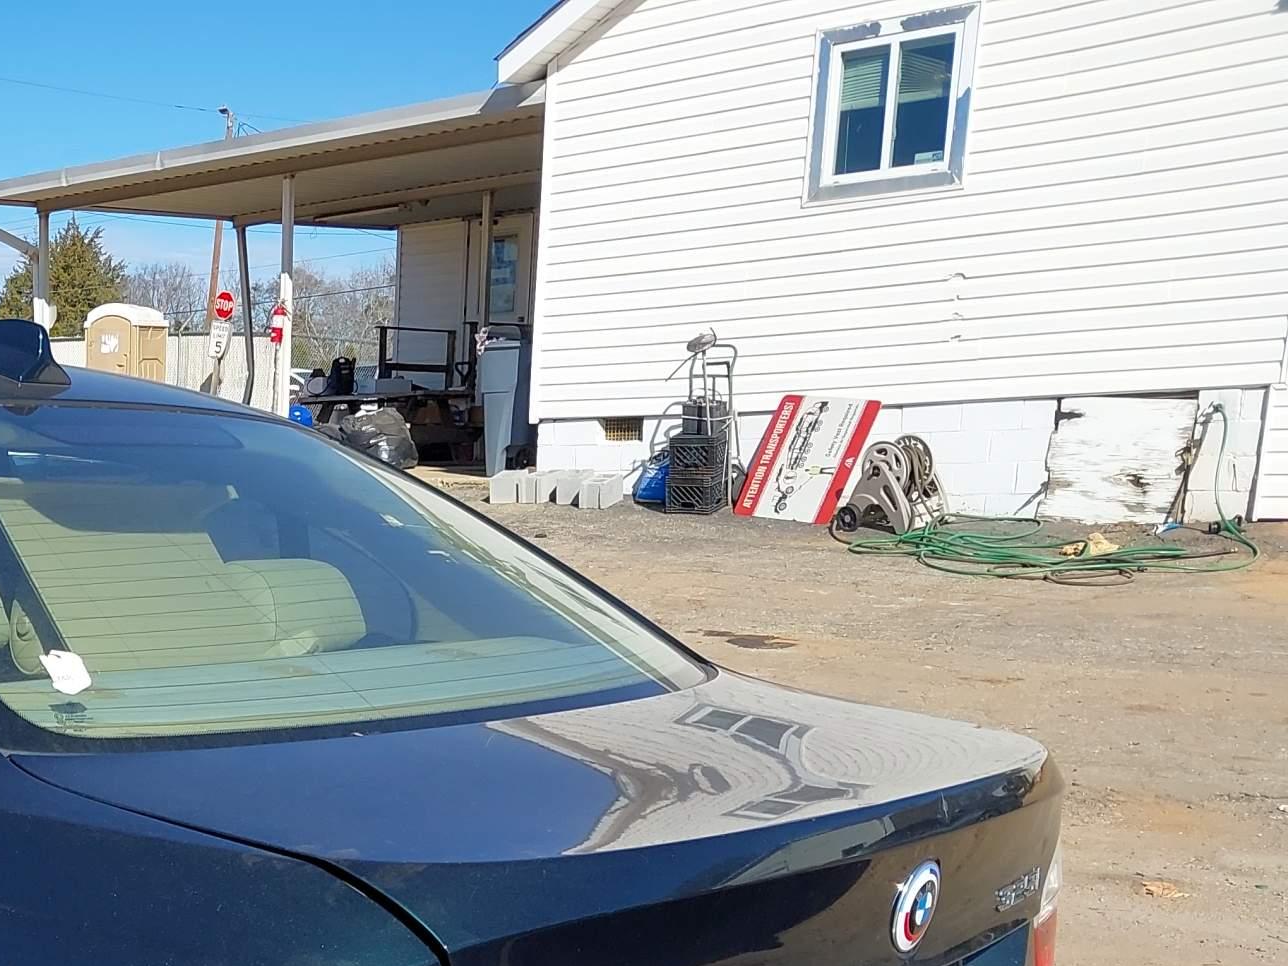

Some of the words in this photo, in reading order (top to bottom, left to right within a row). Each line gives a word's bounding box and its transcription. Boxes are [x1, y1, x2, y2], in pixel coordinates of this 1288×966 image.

[215, 298, 234, 312] STOP
[213, 324, 228, 332] SPEED
[214, 341, 222, 354] 5
[839, 403, 853, 428] Required
[742, 466, 767, 509] ATTENTION
[760, 401, 795, 464] TRANSPORTERS!
